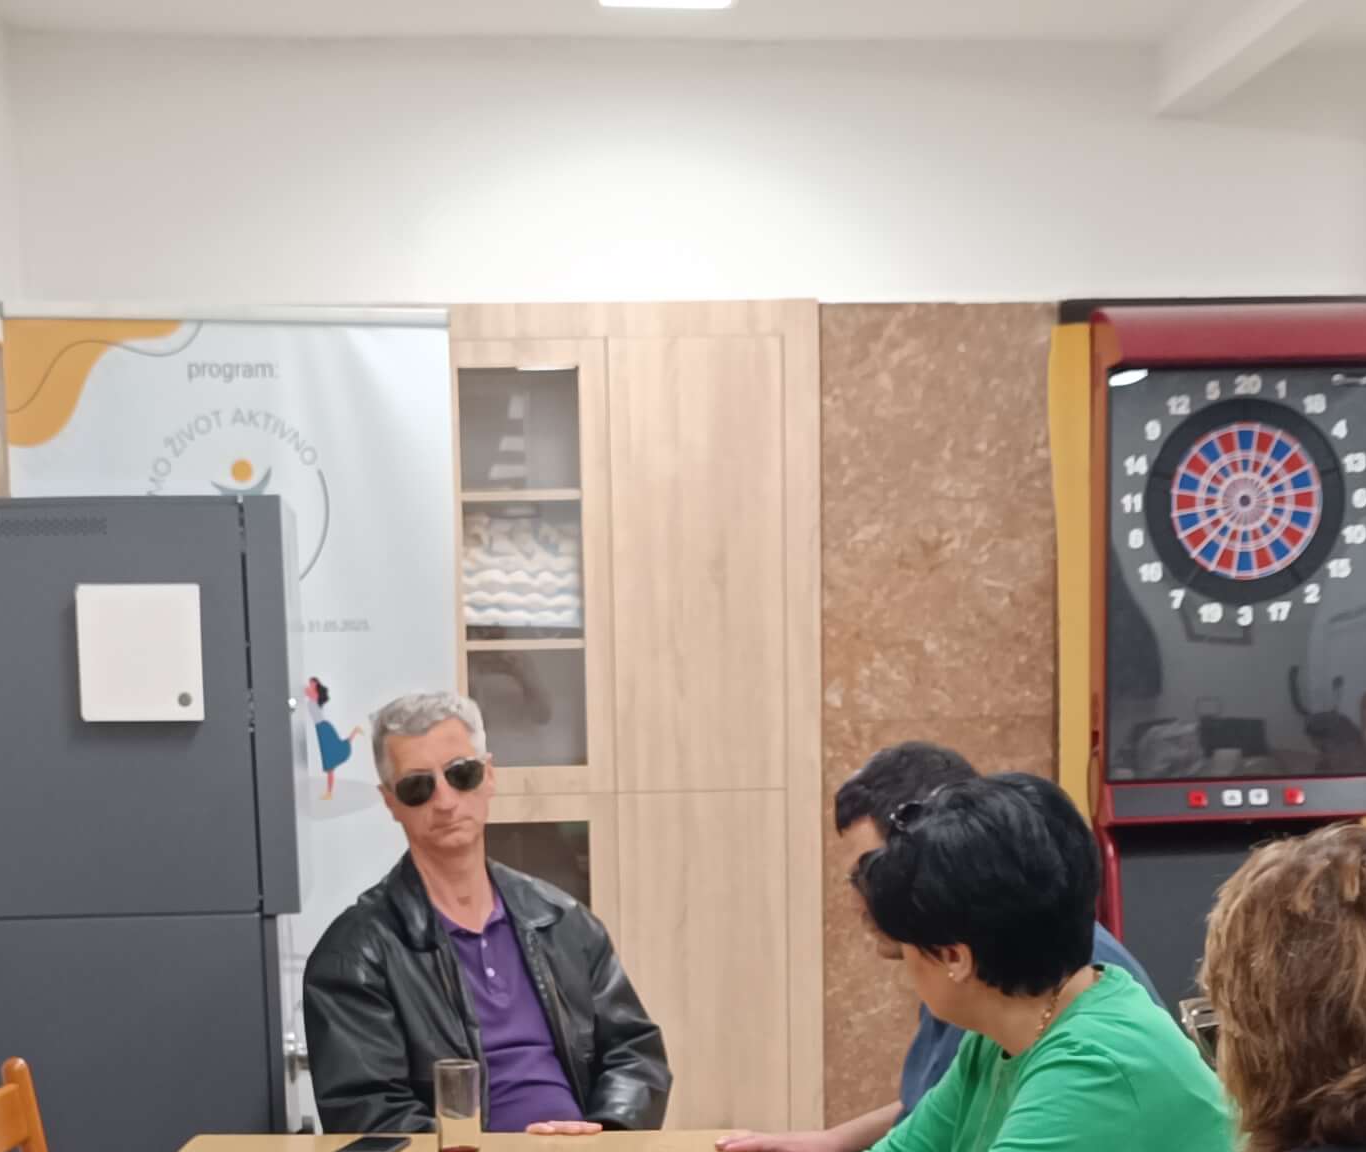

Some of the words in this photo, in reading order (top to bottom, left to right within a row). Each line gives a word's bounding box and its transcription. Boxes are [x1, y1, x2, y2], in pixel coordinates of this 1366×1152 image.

[187, 361, 280, 383] program:
[1234, 373, 1262, 395] 20
[1275, 379, 1287, 399] 1
[1166, 394, 1191, 415] 12
[163, 409, 223, 459] ŽIVOT
[231, 407, 318, 467] AKTIVNO
[1331, 418, 1348, 439] 4
[1123, 454, 1148, 476] 14
[1342, 451, 1366, 473] 13
[1120, 492, 1143, 514] 11
[1327, 557, 1352, 578] 15
[1168, 587, 1186, 609] 7
[1303, 583, 1321, 604] 2
[1236, 604, 1254, 626] 3
[1266, 601, 1292, 622] 17
